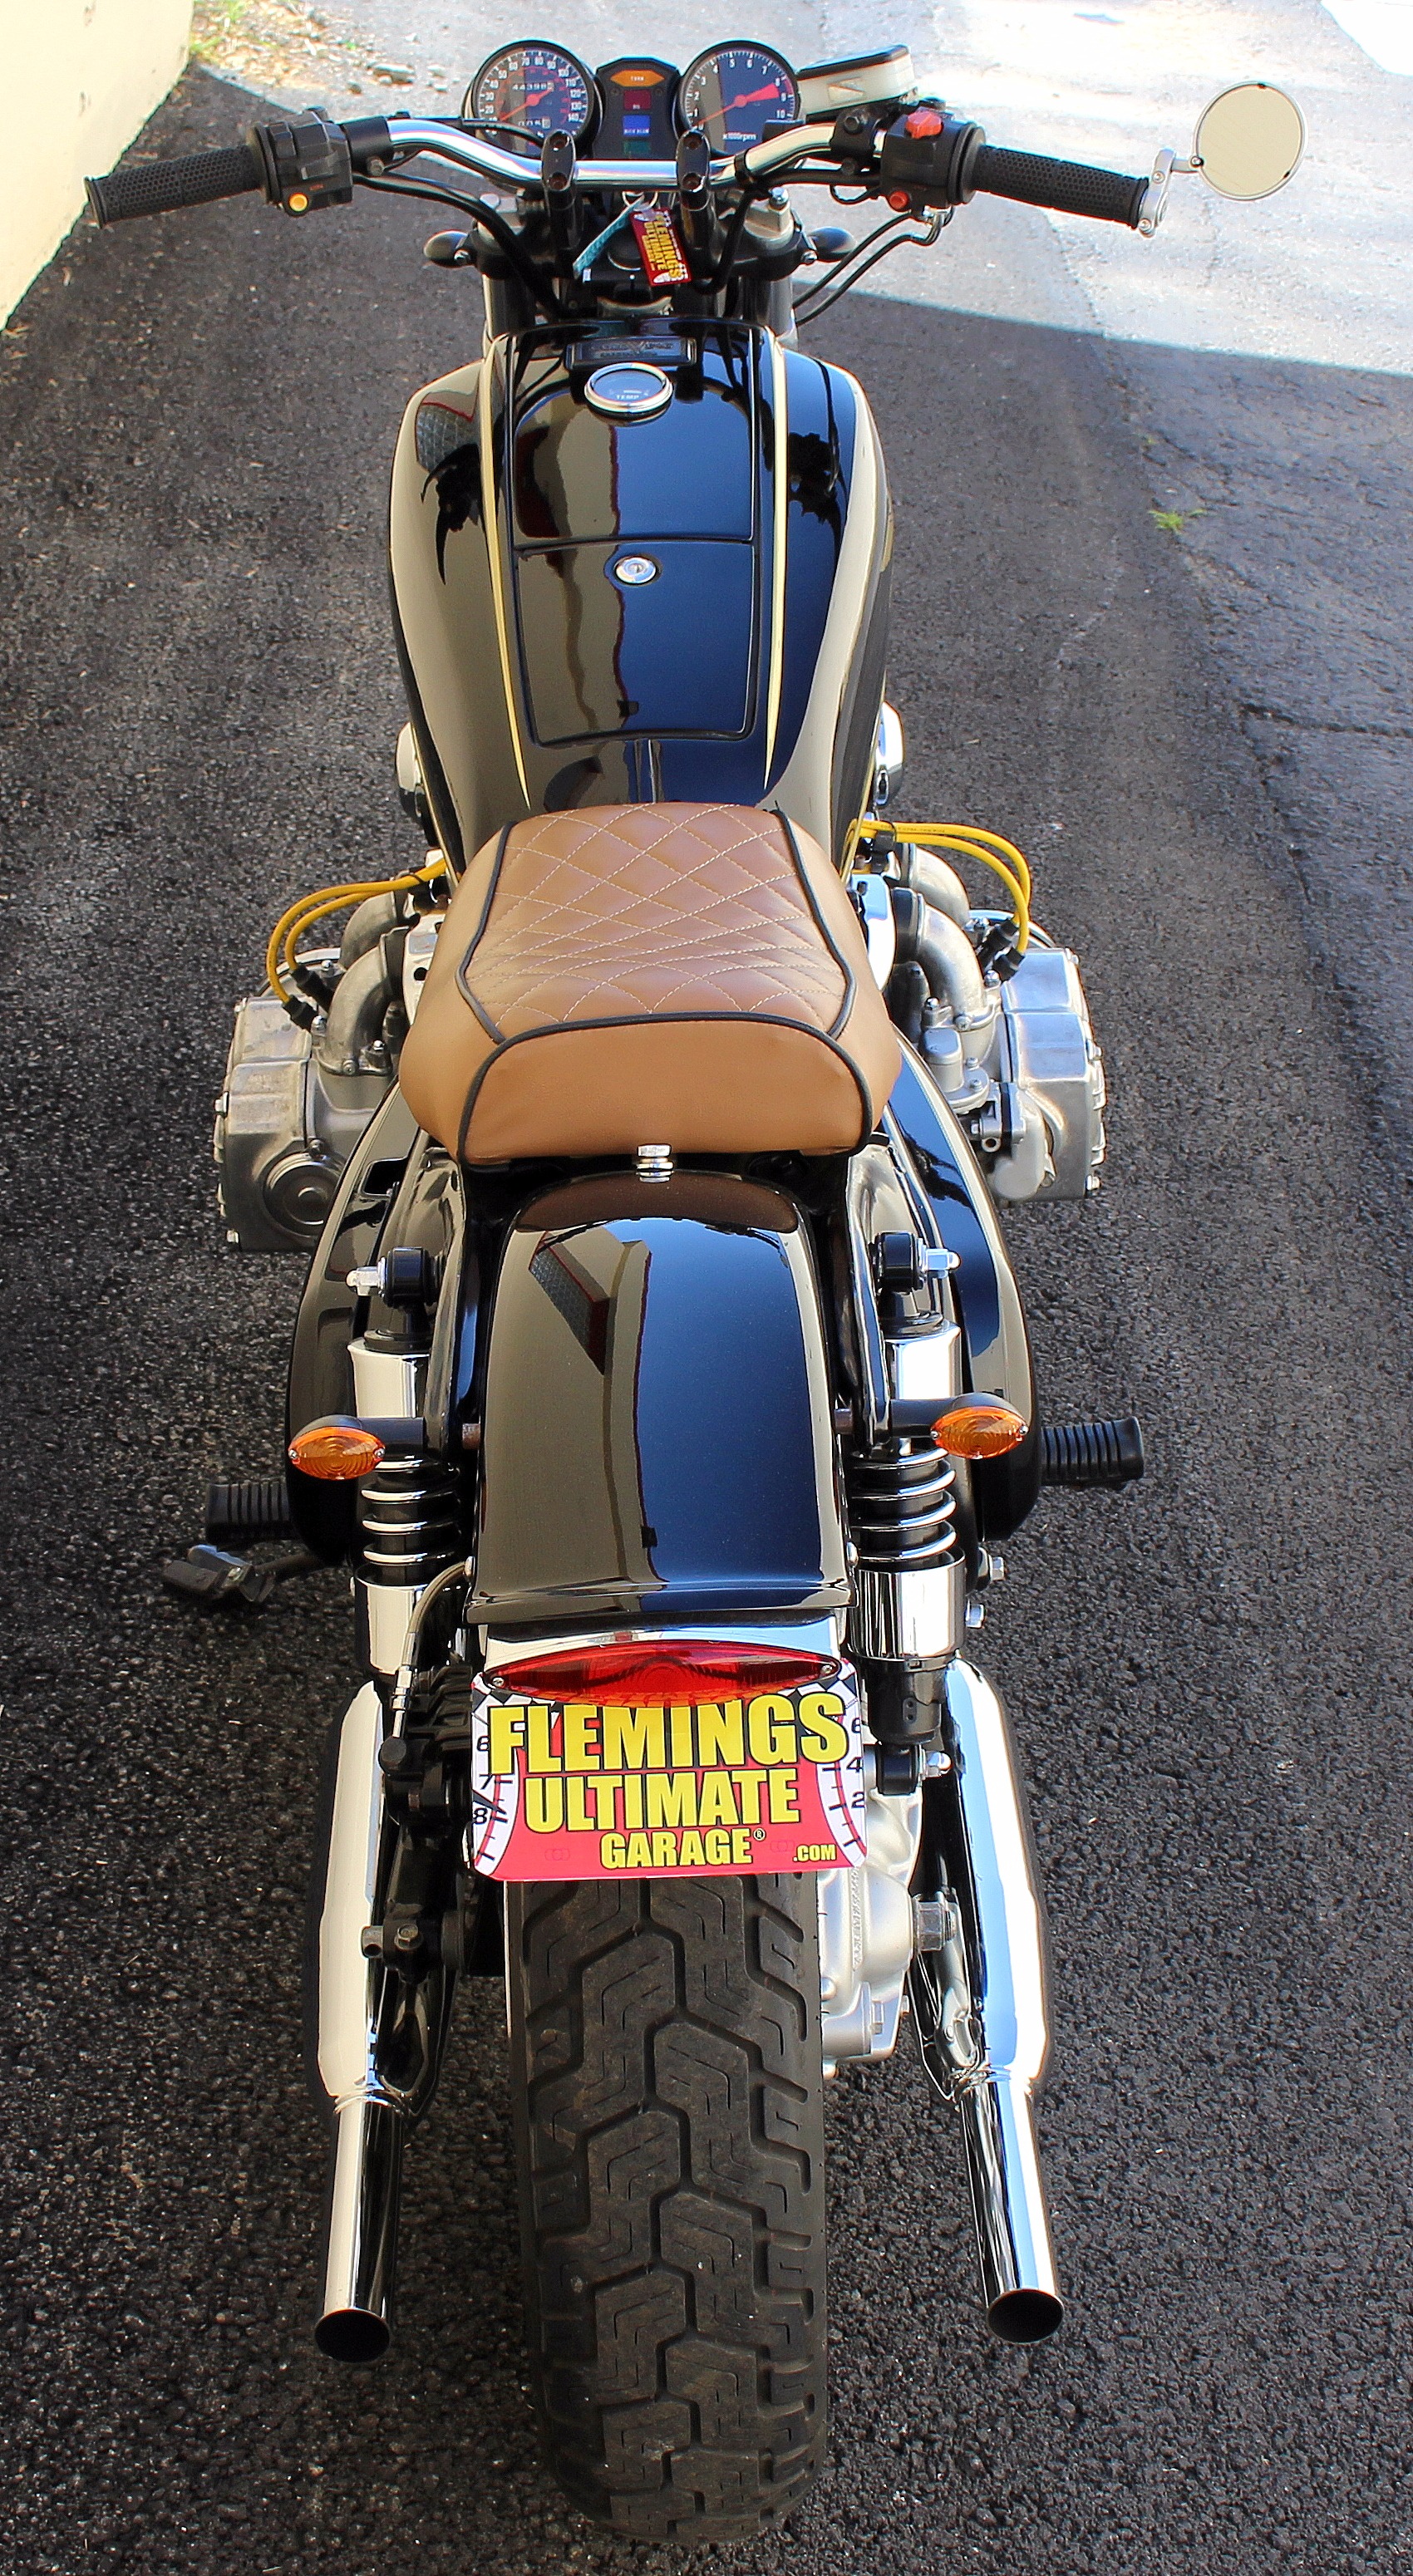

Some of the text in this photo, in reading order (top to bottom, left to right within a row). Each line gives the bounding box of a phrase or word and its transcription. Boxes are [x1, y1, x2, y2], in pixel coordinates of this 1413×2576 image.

[712, 64, 719, 73] 4
[730, 59, 736, 68] 5
[747, 59, 753, 68] 6
[762, 66, 768, 75] 7
[701, 76, 706, 86] 3
[694, 91, 700, 101] 2
[776, 109, 785, 119] 10
[488, 1692, 847, 1775] FLEMINGS
[846, 1757, 864, 1773] 4
[479, 1773, 494, 1790] 7
[524, 1768, 800, 1834] ULTIMATE
[851, 1791, 864, 1809] 2
[473, 1807, 488, 1825] 8
[793, 1844, 836, 1862] .COM
